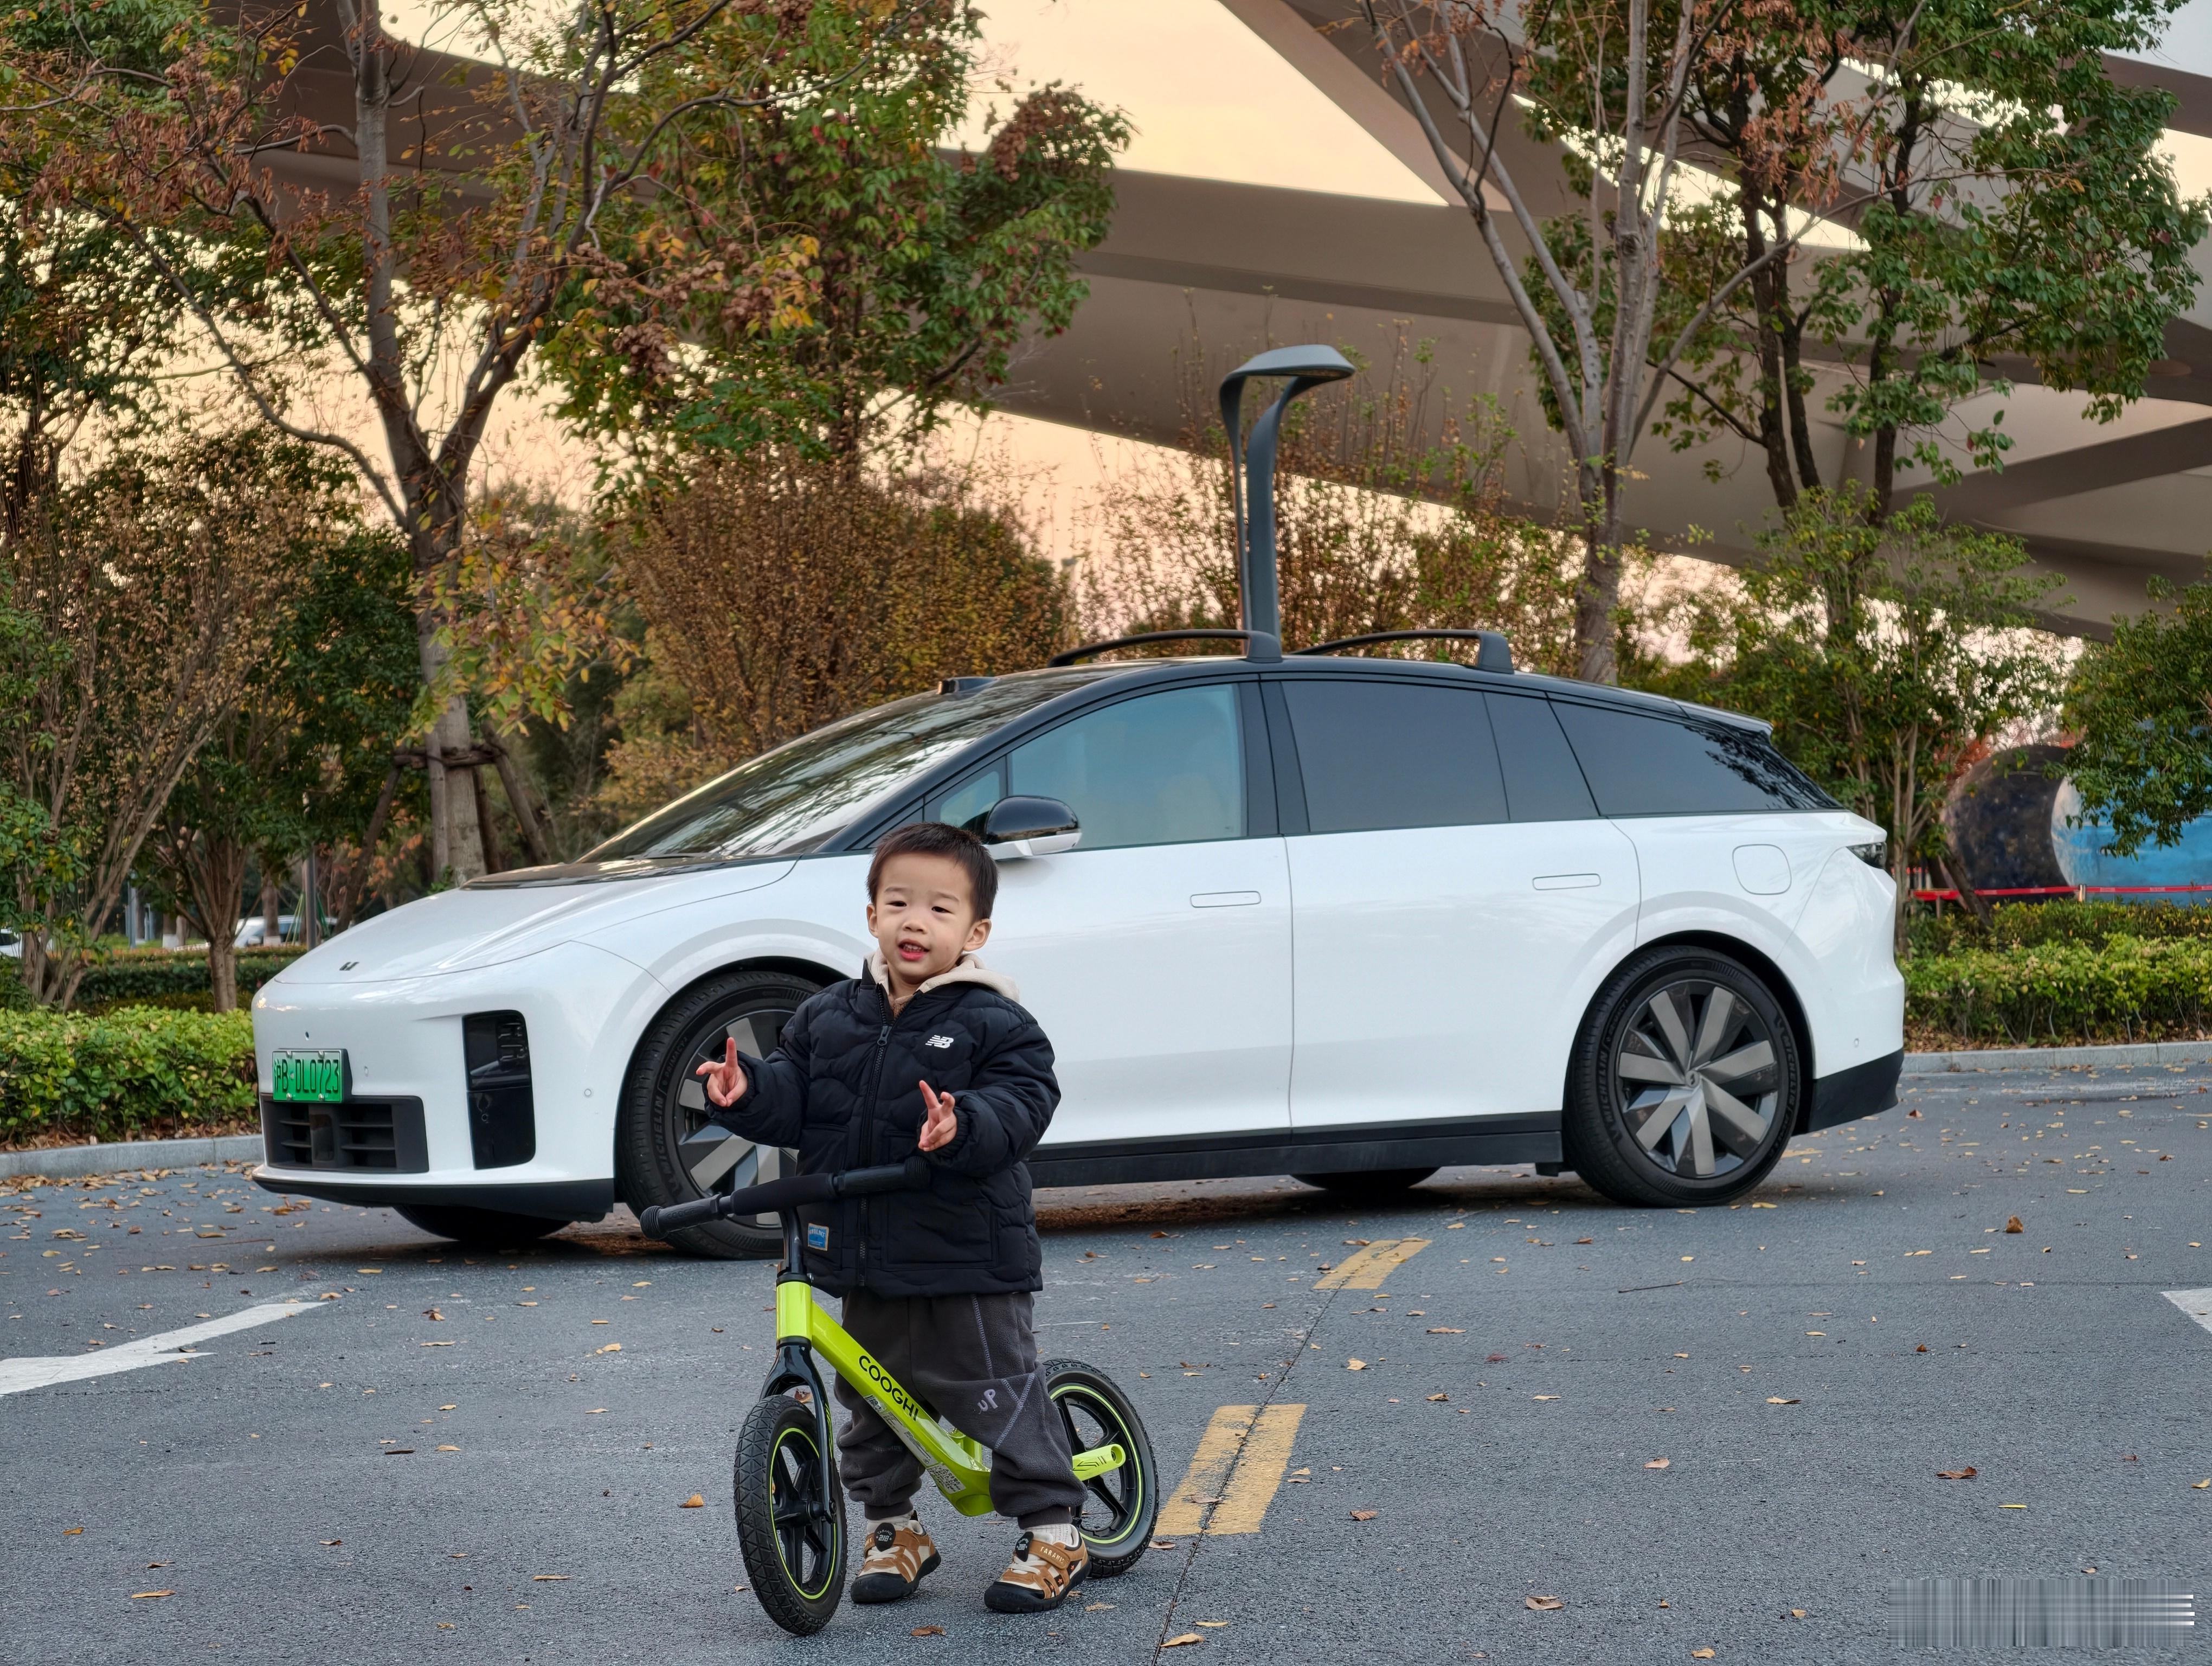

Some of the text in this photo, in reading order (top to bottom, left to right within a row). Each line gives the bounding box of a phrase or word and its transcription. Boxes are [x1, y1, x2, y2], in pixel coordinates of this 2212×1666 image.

[1599, 1050, 1613, 1123] MICHELIN
[653, 1095, 671, 1174] MICHELIN
[859, 1355, 919, 1421] COOGHI
[1040, 1546, 1064, 1564] TARANIS
